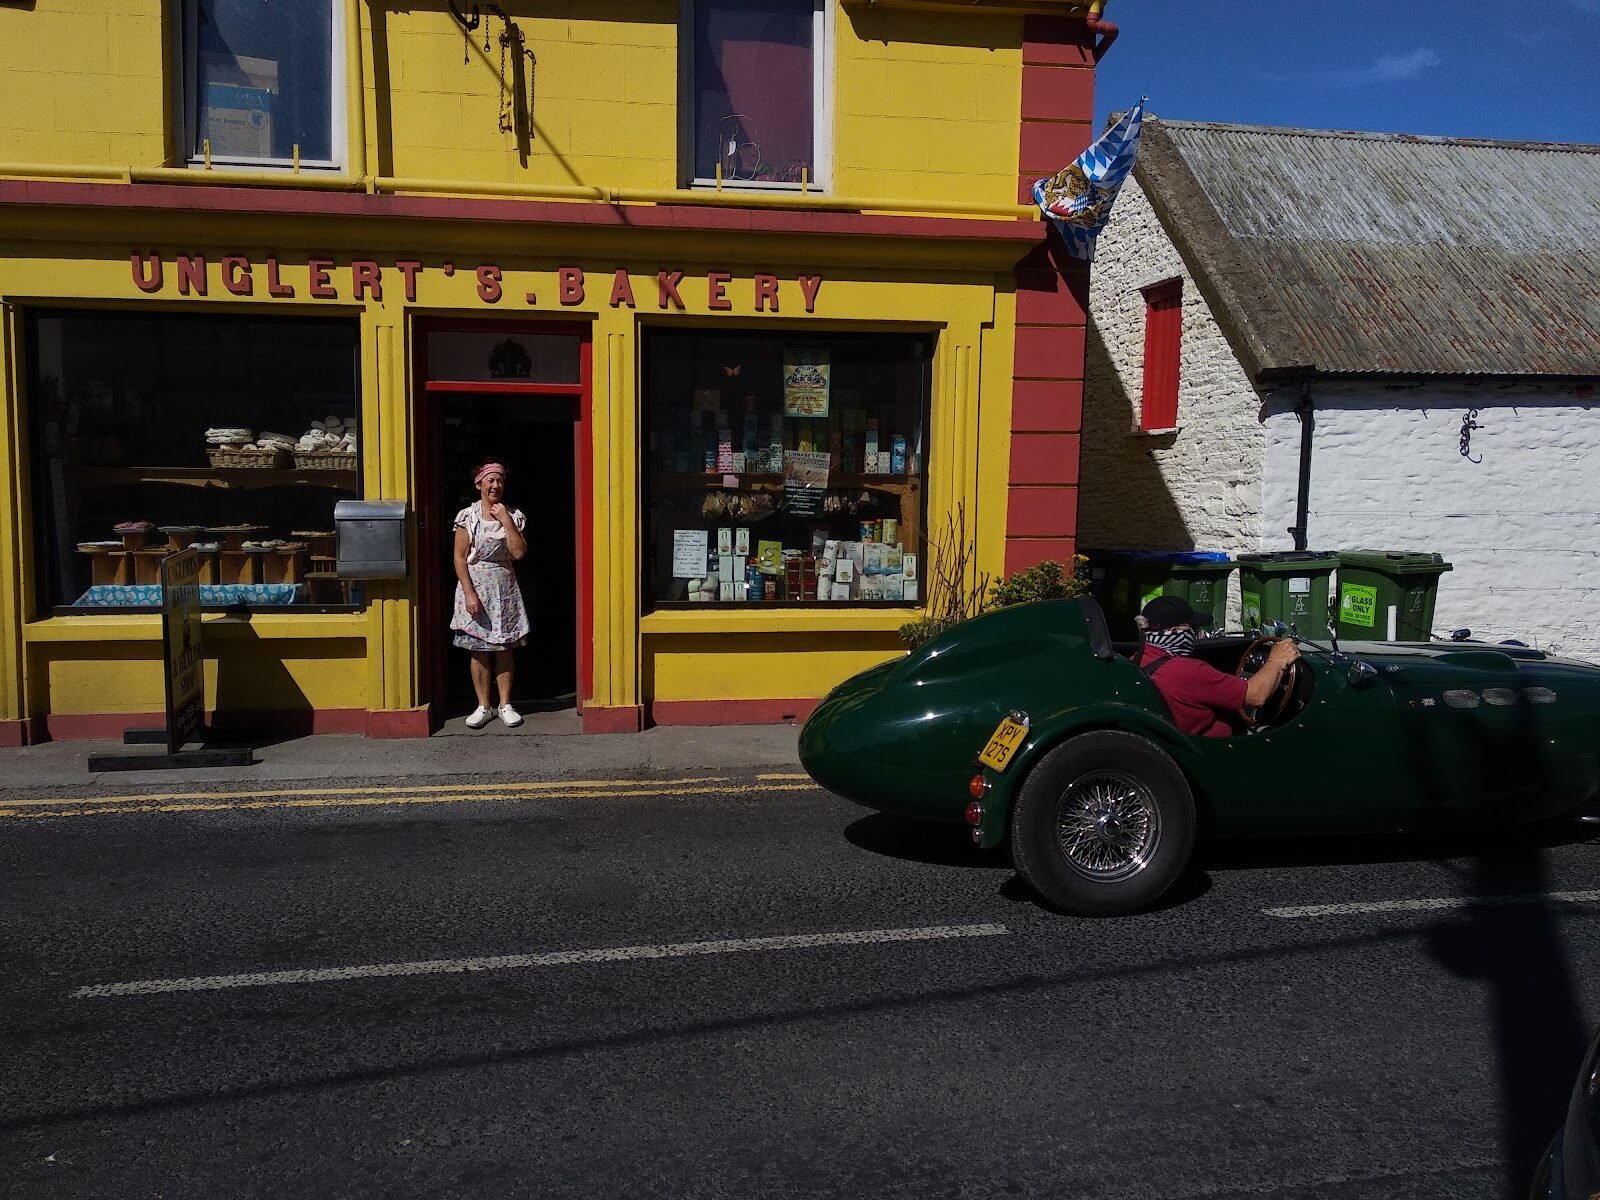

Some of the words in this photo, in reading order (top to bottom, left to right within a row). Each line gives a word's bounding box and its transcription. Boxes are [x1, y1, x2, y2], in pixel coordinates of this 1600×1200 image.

[559, 267, 822, 313] BAKERY
[1352, 595, 1373, 606] GLASS
[1353, 604, 1370, 613] ONLY
